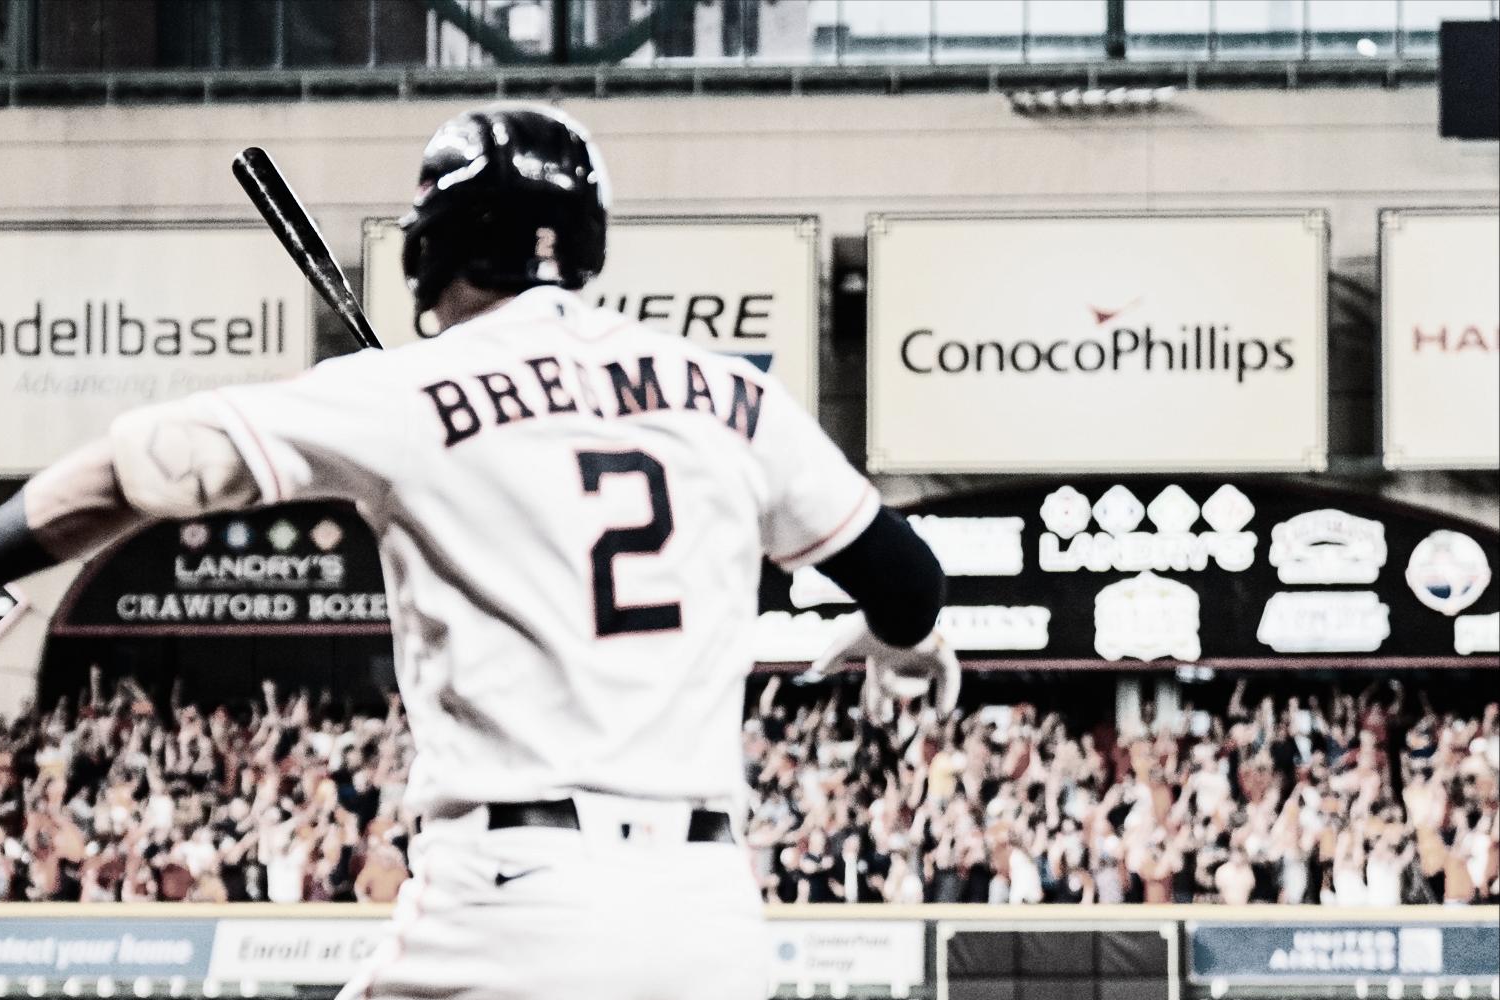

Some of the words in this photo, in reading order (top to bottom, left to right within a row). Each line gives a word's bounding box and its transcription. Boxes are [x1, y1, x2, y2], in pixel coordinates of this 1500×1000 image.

[900, 324, 1295, 383] ConocoPhillips
[1412, 322, 1499, 354] HA
[576, 447, 682, 640] 2
[174, 553, 346, 583] LANDRY'S
[116, 592, 296, 621] CRAWFORD
[308, 592, 391, 621] BOXE
